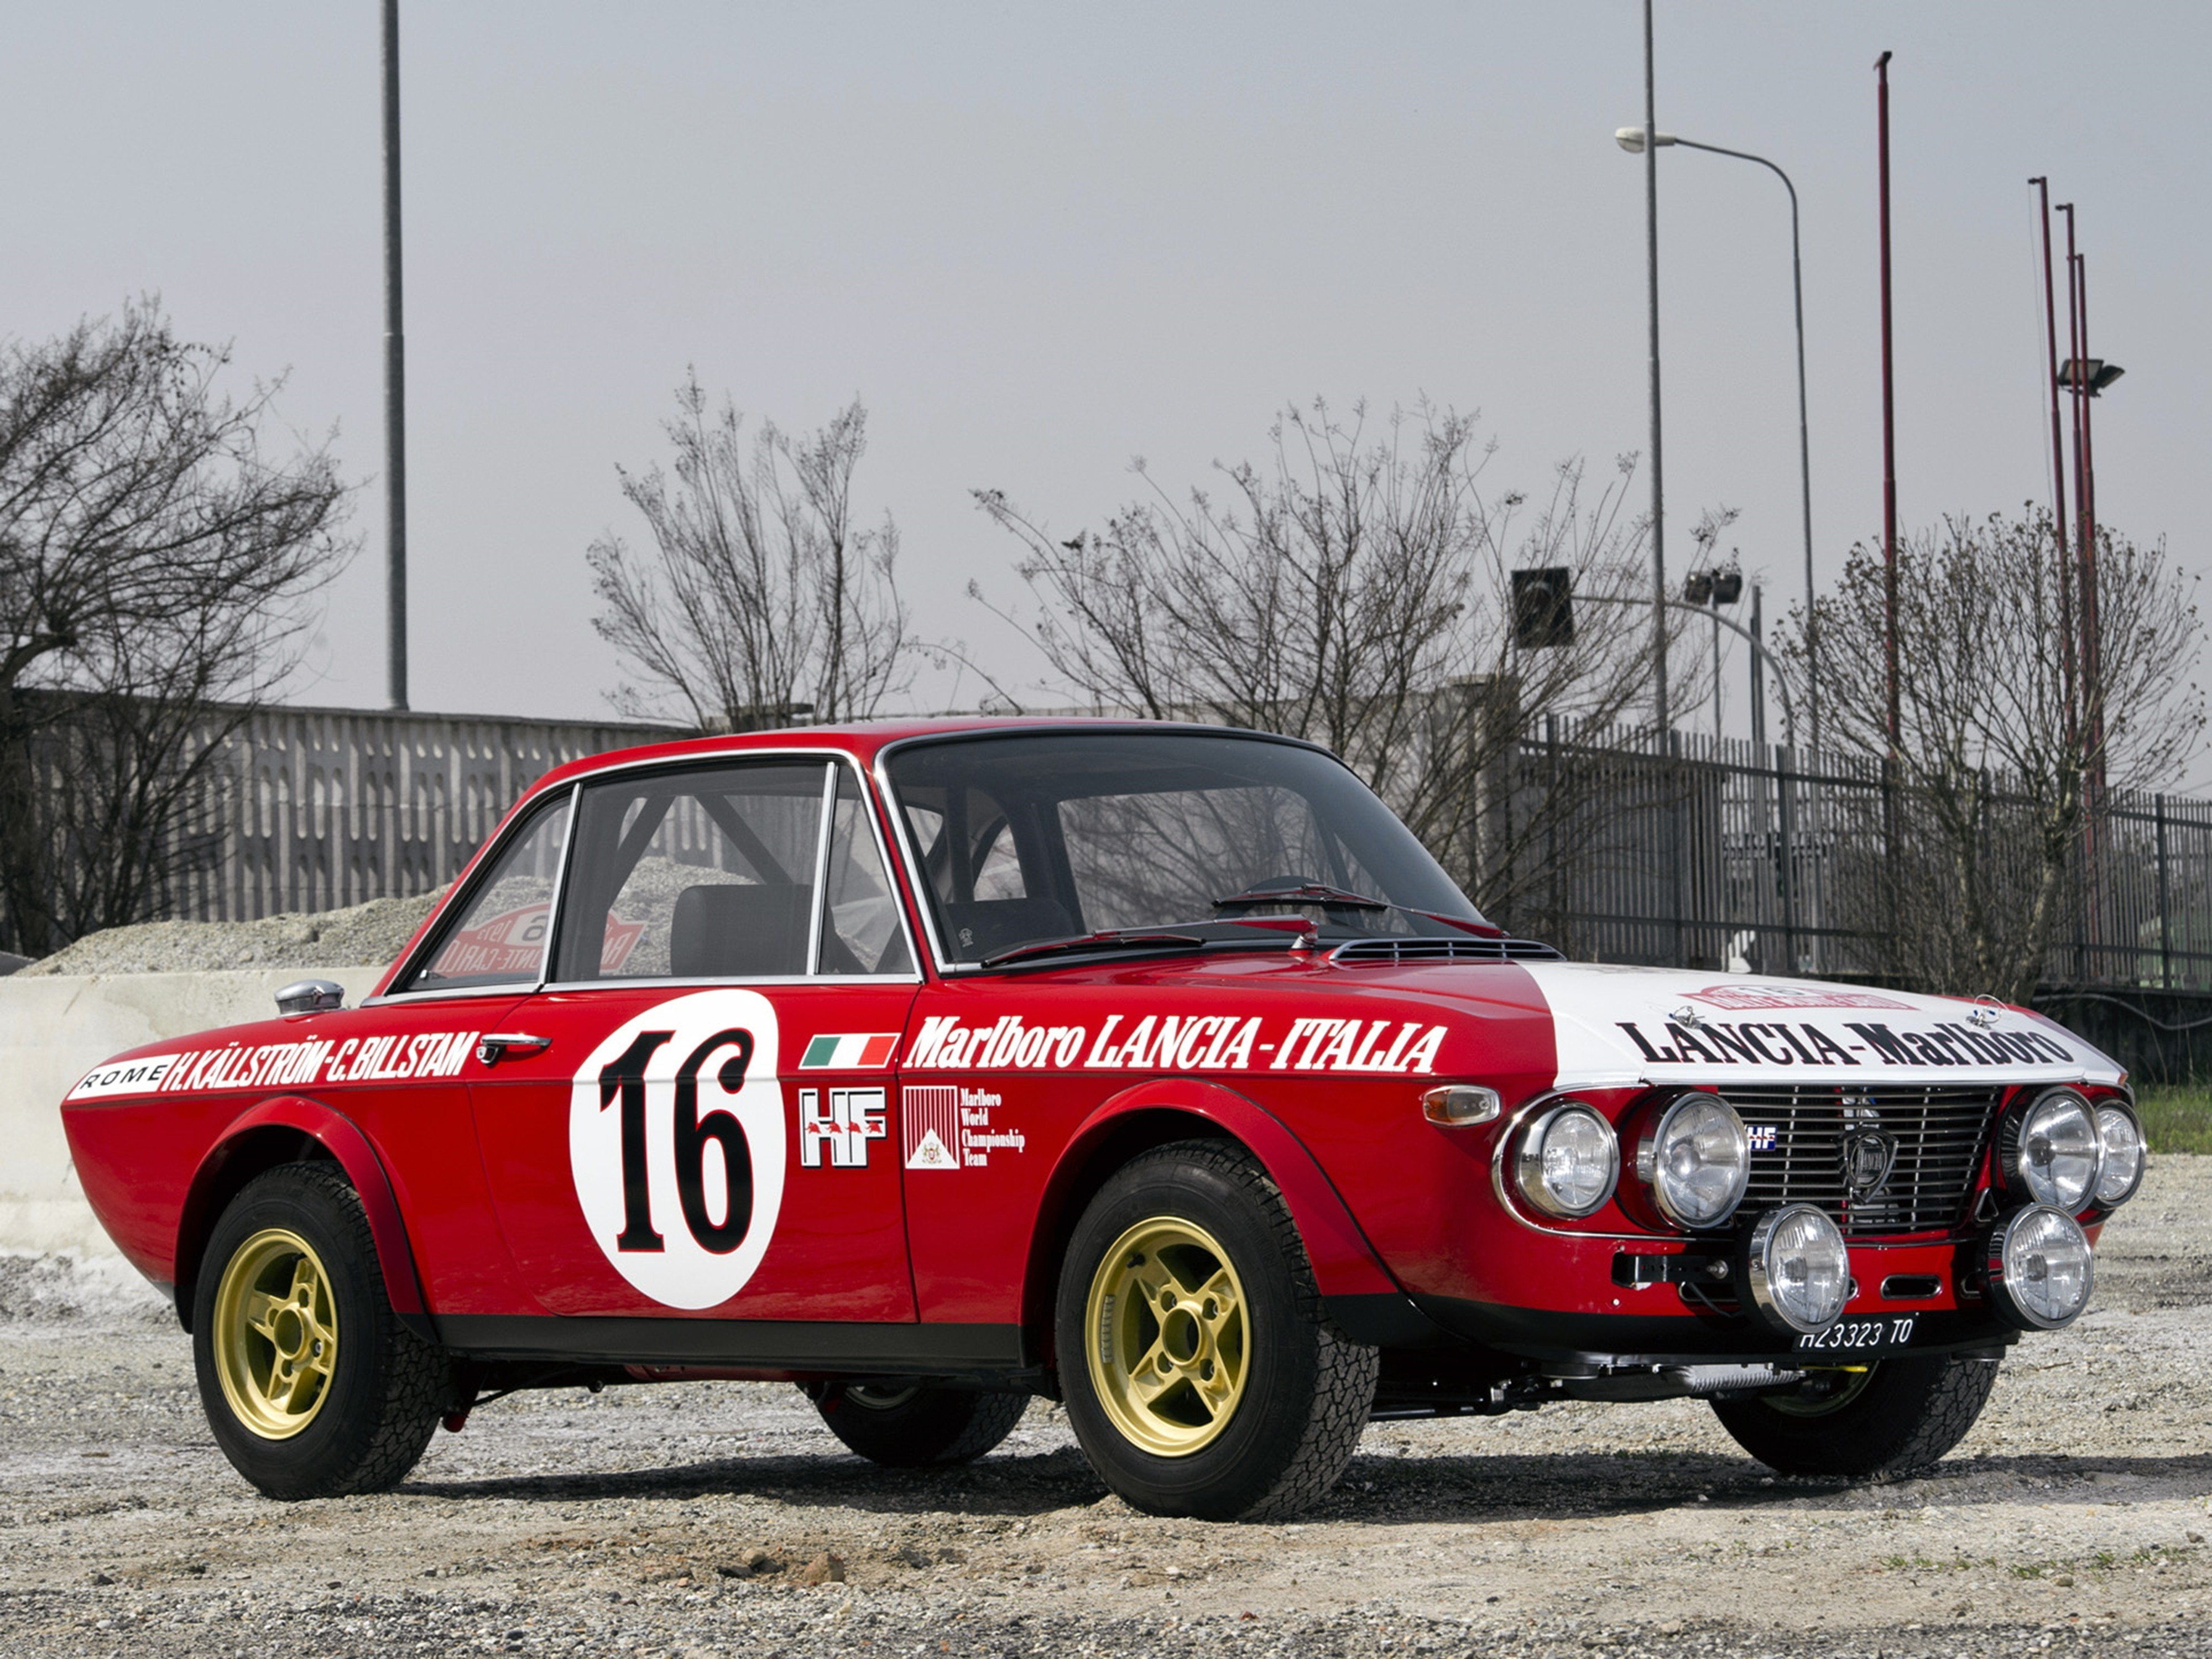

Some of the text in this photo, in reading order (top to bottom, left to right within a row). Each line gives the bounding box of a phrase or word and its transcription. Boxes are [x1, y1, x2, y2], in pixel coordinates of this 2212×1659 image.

[902, 1015, 1087, 1070] Marlboro
[79, 1064, 168, 1089] ROME
[960, 1088, 1001, 1107] Marlboro
[799, 1087, 887, 1168] HF
[960, 1107, 989, 1126] World
[599, 1027, 754, 1254] 16
[961, 1129, 1026, 1153] Championship
[1747, 1126, 1777, 1150] HF
[962, 1147, 988, 1166] Team
[1890, 1319, 1913, 1344] TO
